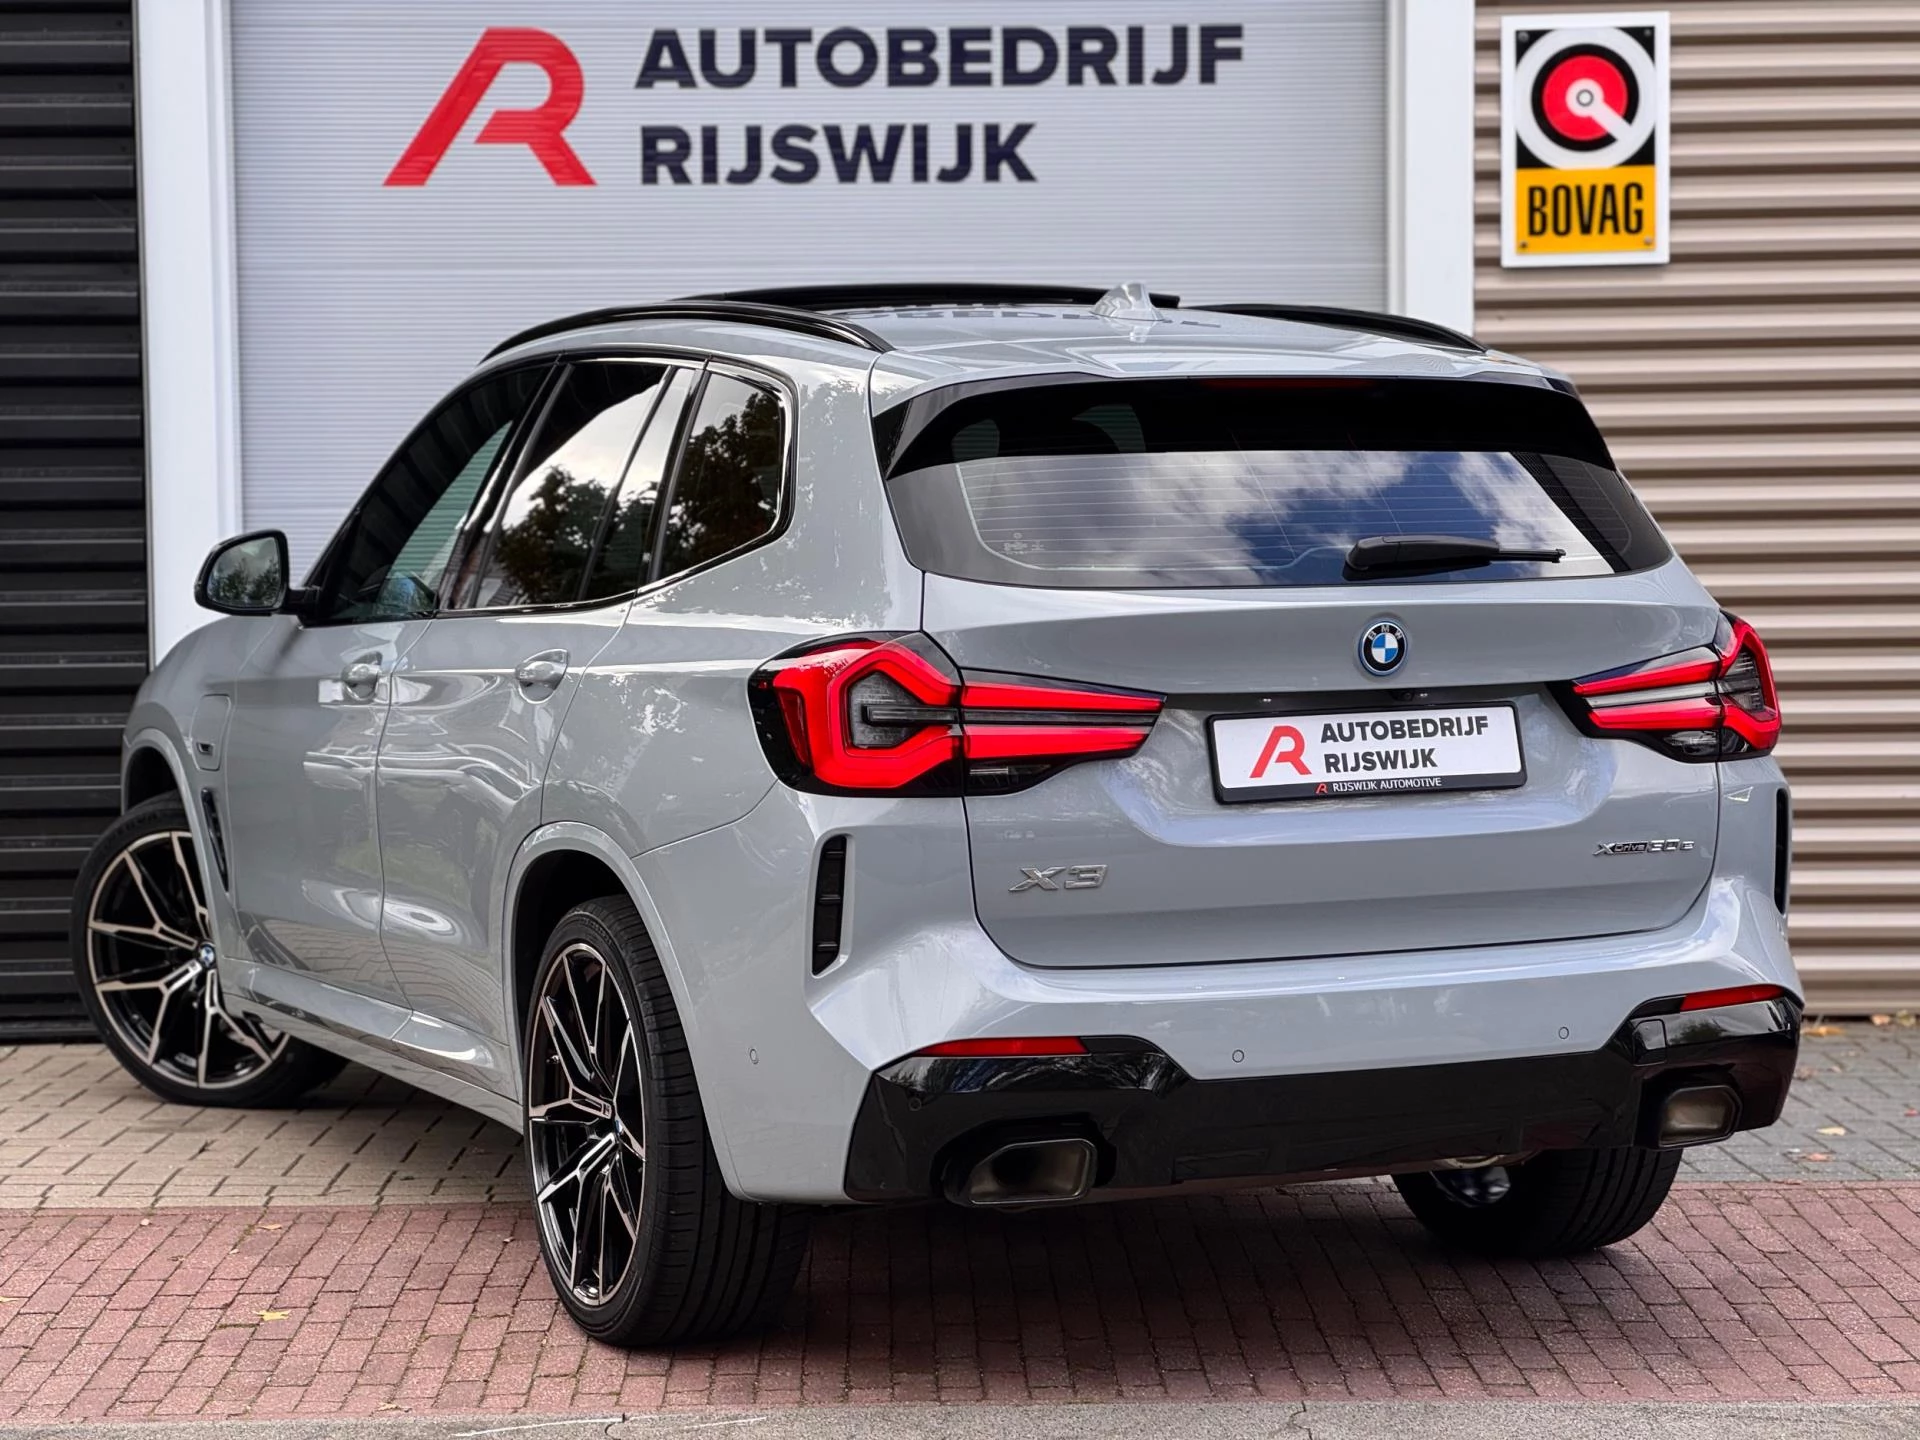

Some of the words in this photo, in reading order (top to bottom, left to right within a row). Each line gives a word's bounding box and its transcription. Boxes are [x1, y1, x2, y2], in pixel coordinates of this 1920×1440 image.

[635, 24, 1243, 89] AUTOBEDRIJF
[640, 122, 1037, 185] RIJSWIJK
[1528, 182, 1644, 236] BOVAG
[1320, 715, 1489, 743] AUTOBEDRIJF
[1324, 747, 1438, 773] RIJSWIJK
[1333, 779, 1378, 792] RIJSWIJK
[1380, 777, 1442, 790] AUTOMOTIVE
[1008, 864, 1107, 891] X3
